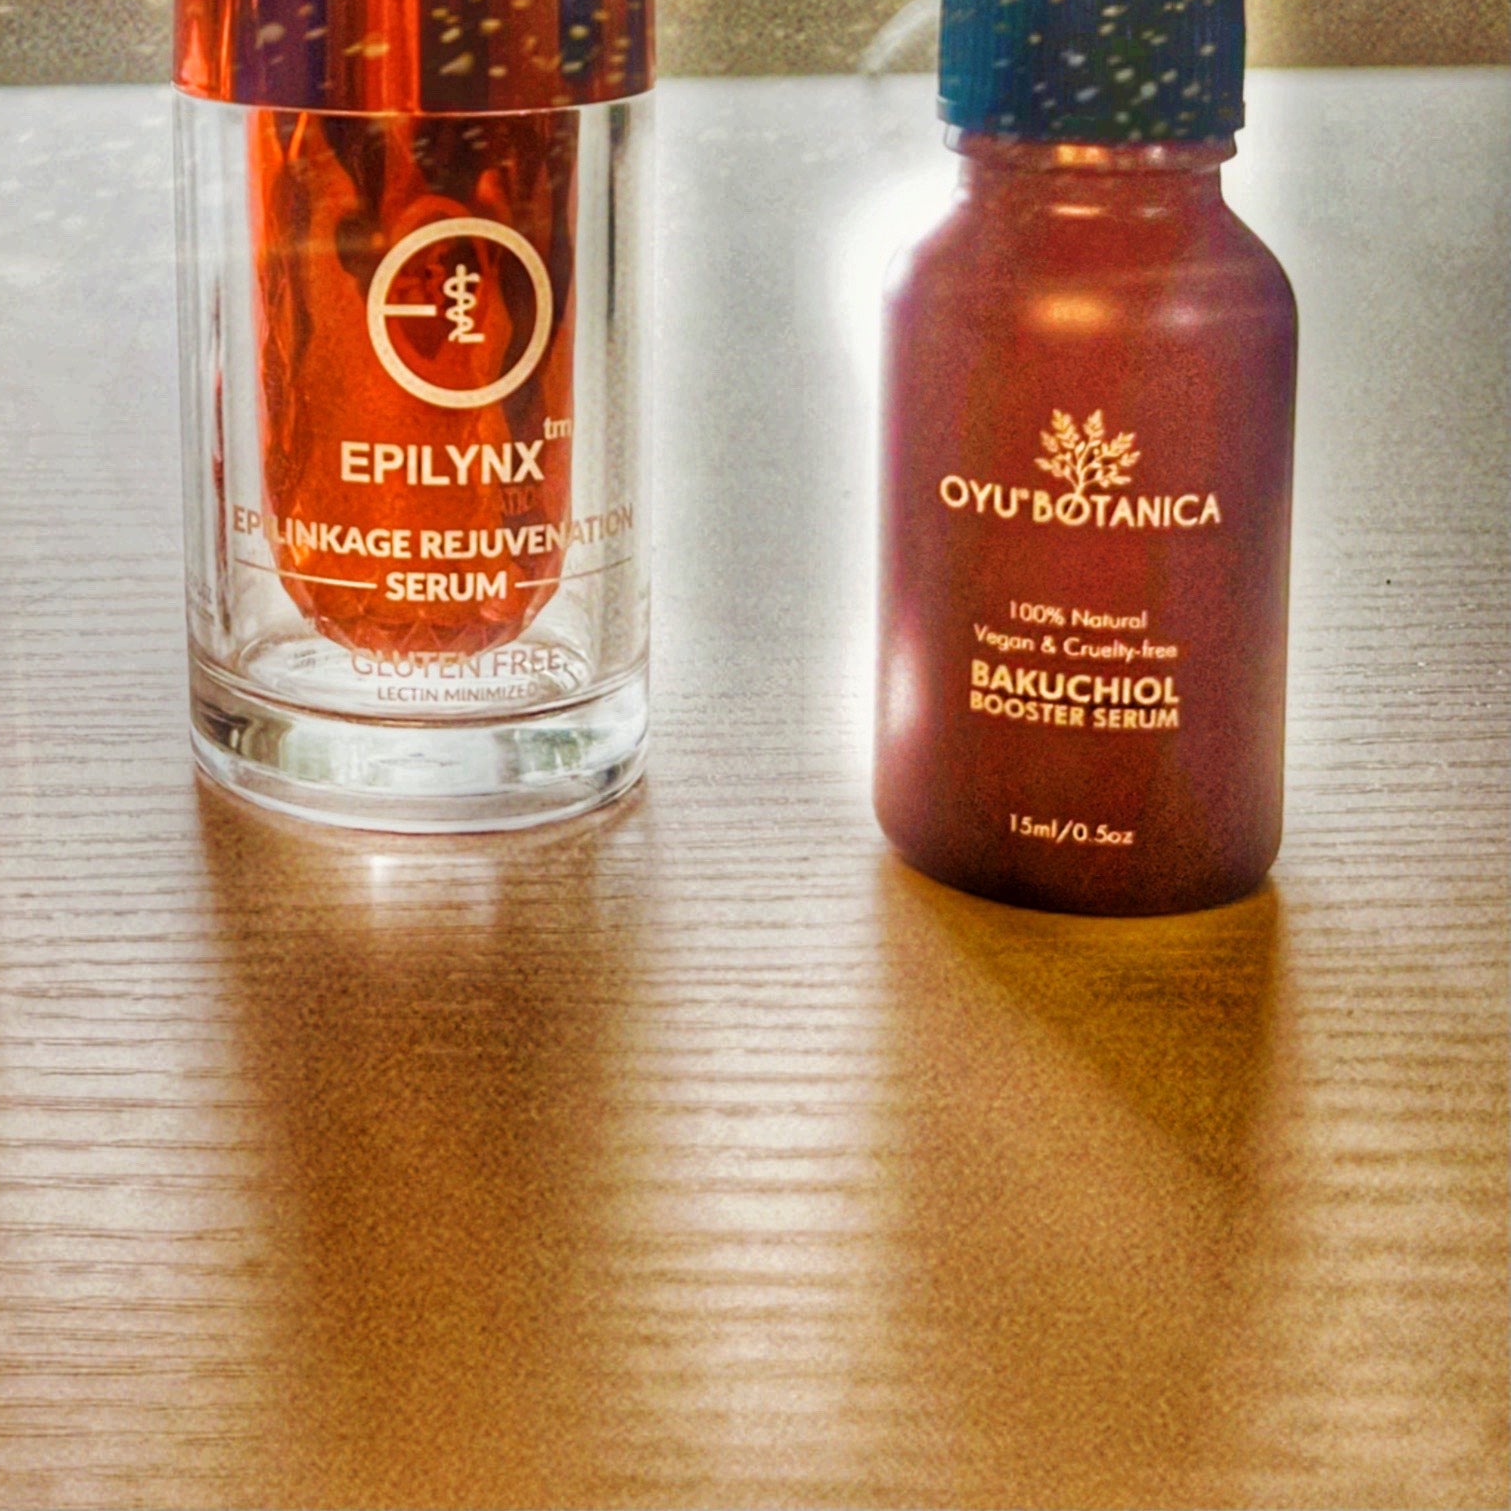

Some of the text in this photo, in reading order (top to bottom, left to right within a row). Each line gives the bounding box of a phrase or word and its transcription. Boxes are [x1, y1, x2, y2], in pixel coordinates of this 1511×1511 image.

[340, 440, 544, 485] EPILYNX
[1033, 491, 1221, 528] BOTANICA
[420, 502, 633, 560] REJUVENATION
[385, 570, 507, 602] SERUM
[1010, 600, 1148, 629] 100% Natural
[973, 622, 1178, 663] Vegan & Cruelty-free
[350, 647, 481, 680] GLUTEN
[493, 645, 561, 677] FREE
[377, 680, 539, 703] LECTIN MINIMIZED
[971, 659, 1180, 705] BAKUCHIOL
[970, 690, 1180, 728] BOOSTER SERUM
[1009, 813, 1134, 844] 15ml/0.5oz
